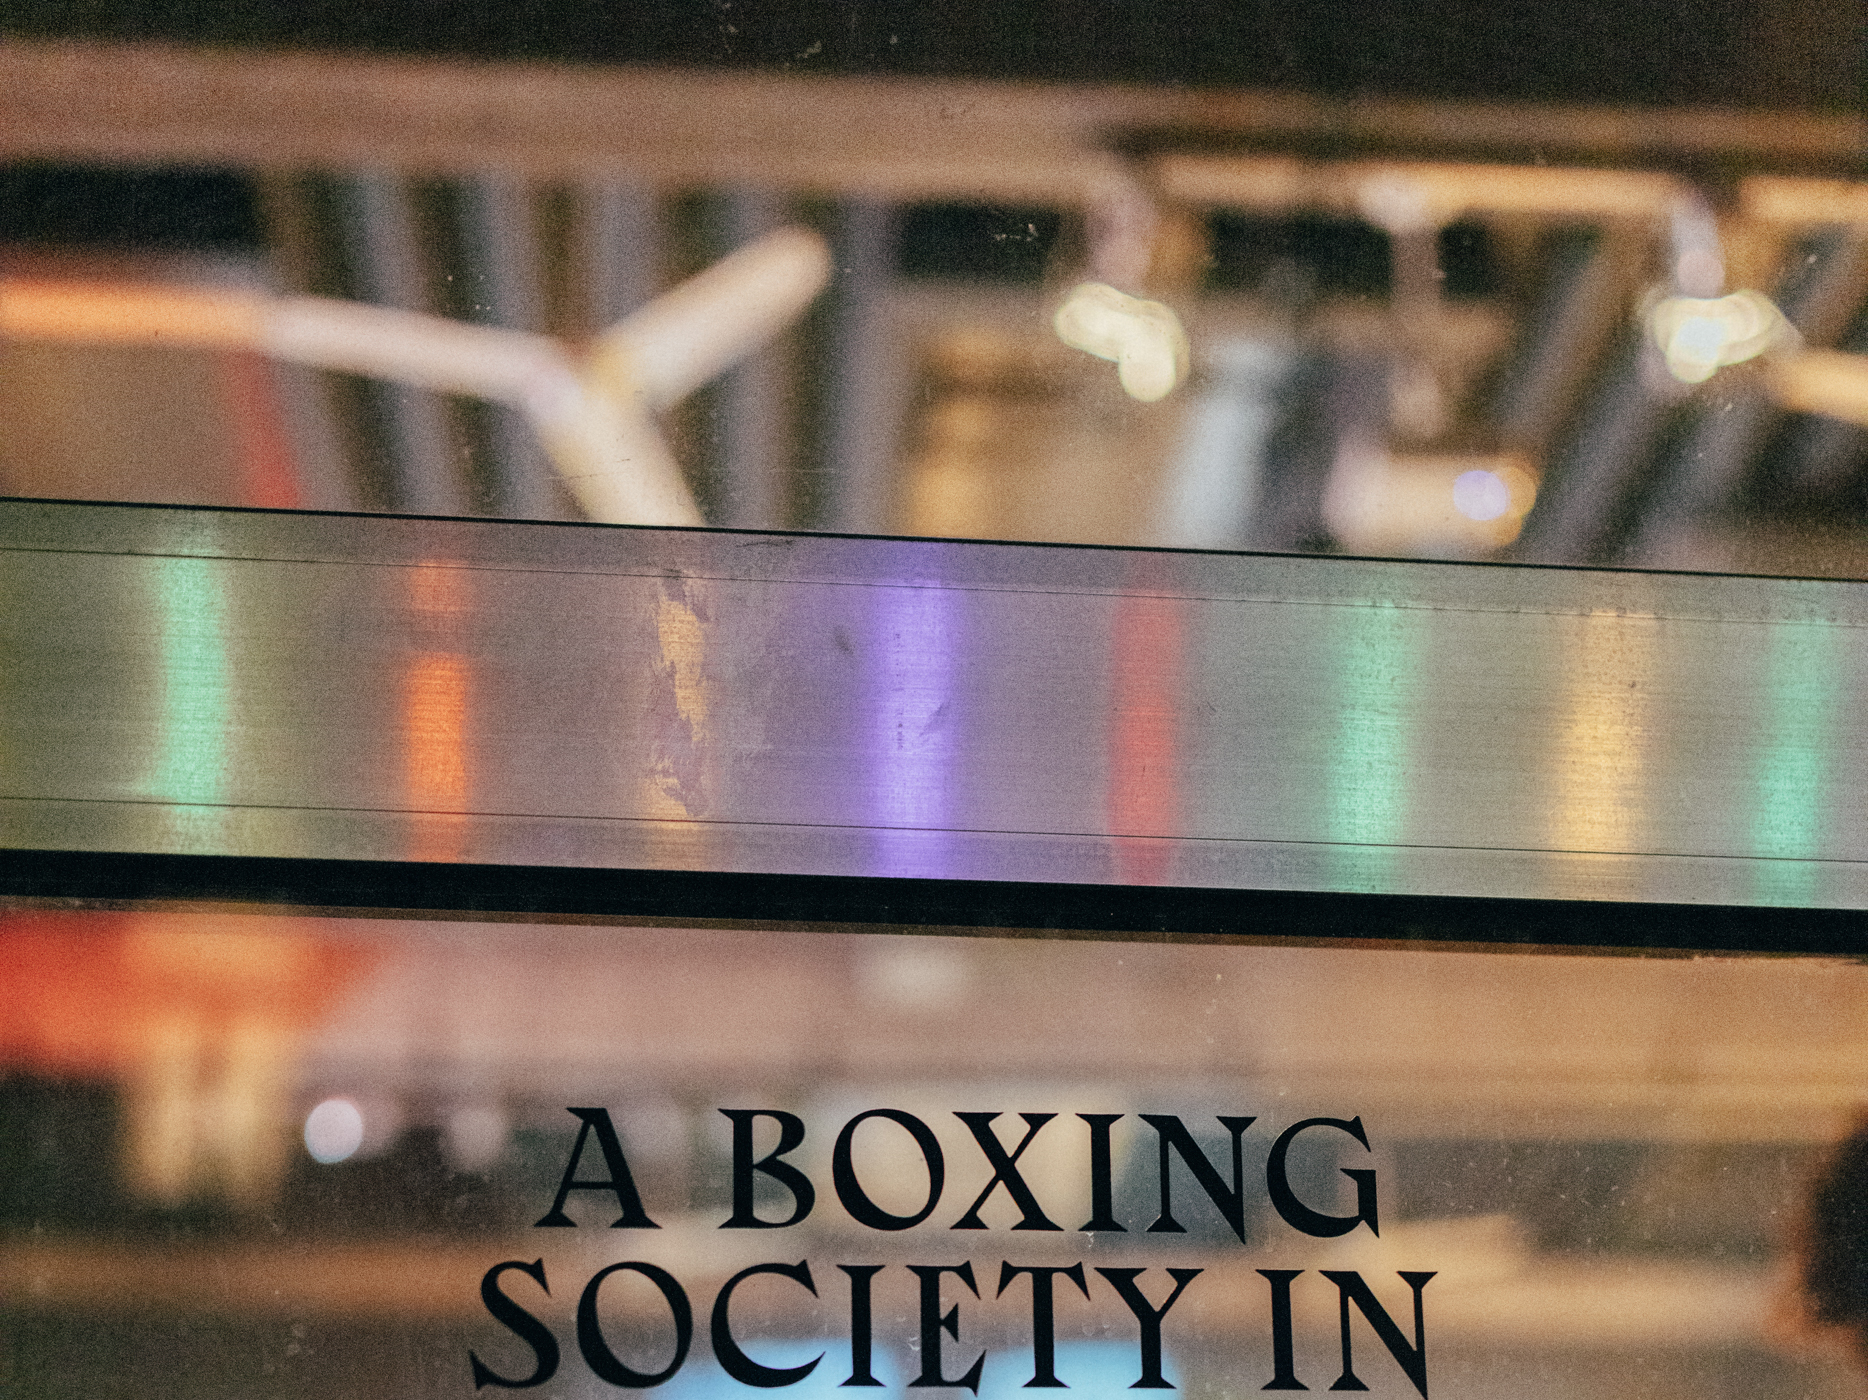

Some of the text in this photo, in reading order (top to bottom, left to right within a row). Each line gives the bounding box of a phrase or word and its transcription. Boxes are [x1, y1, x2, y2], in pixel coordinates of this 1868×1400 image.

[534, 1106, 1380, 1245] A BOXING
[468, 1257, 1204, 1397] SOCIETY
